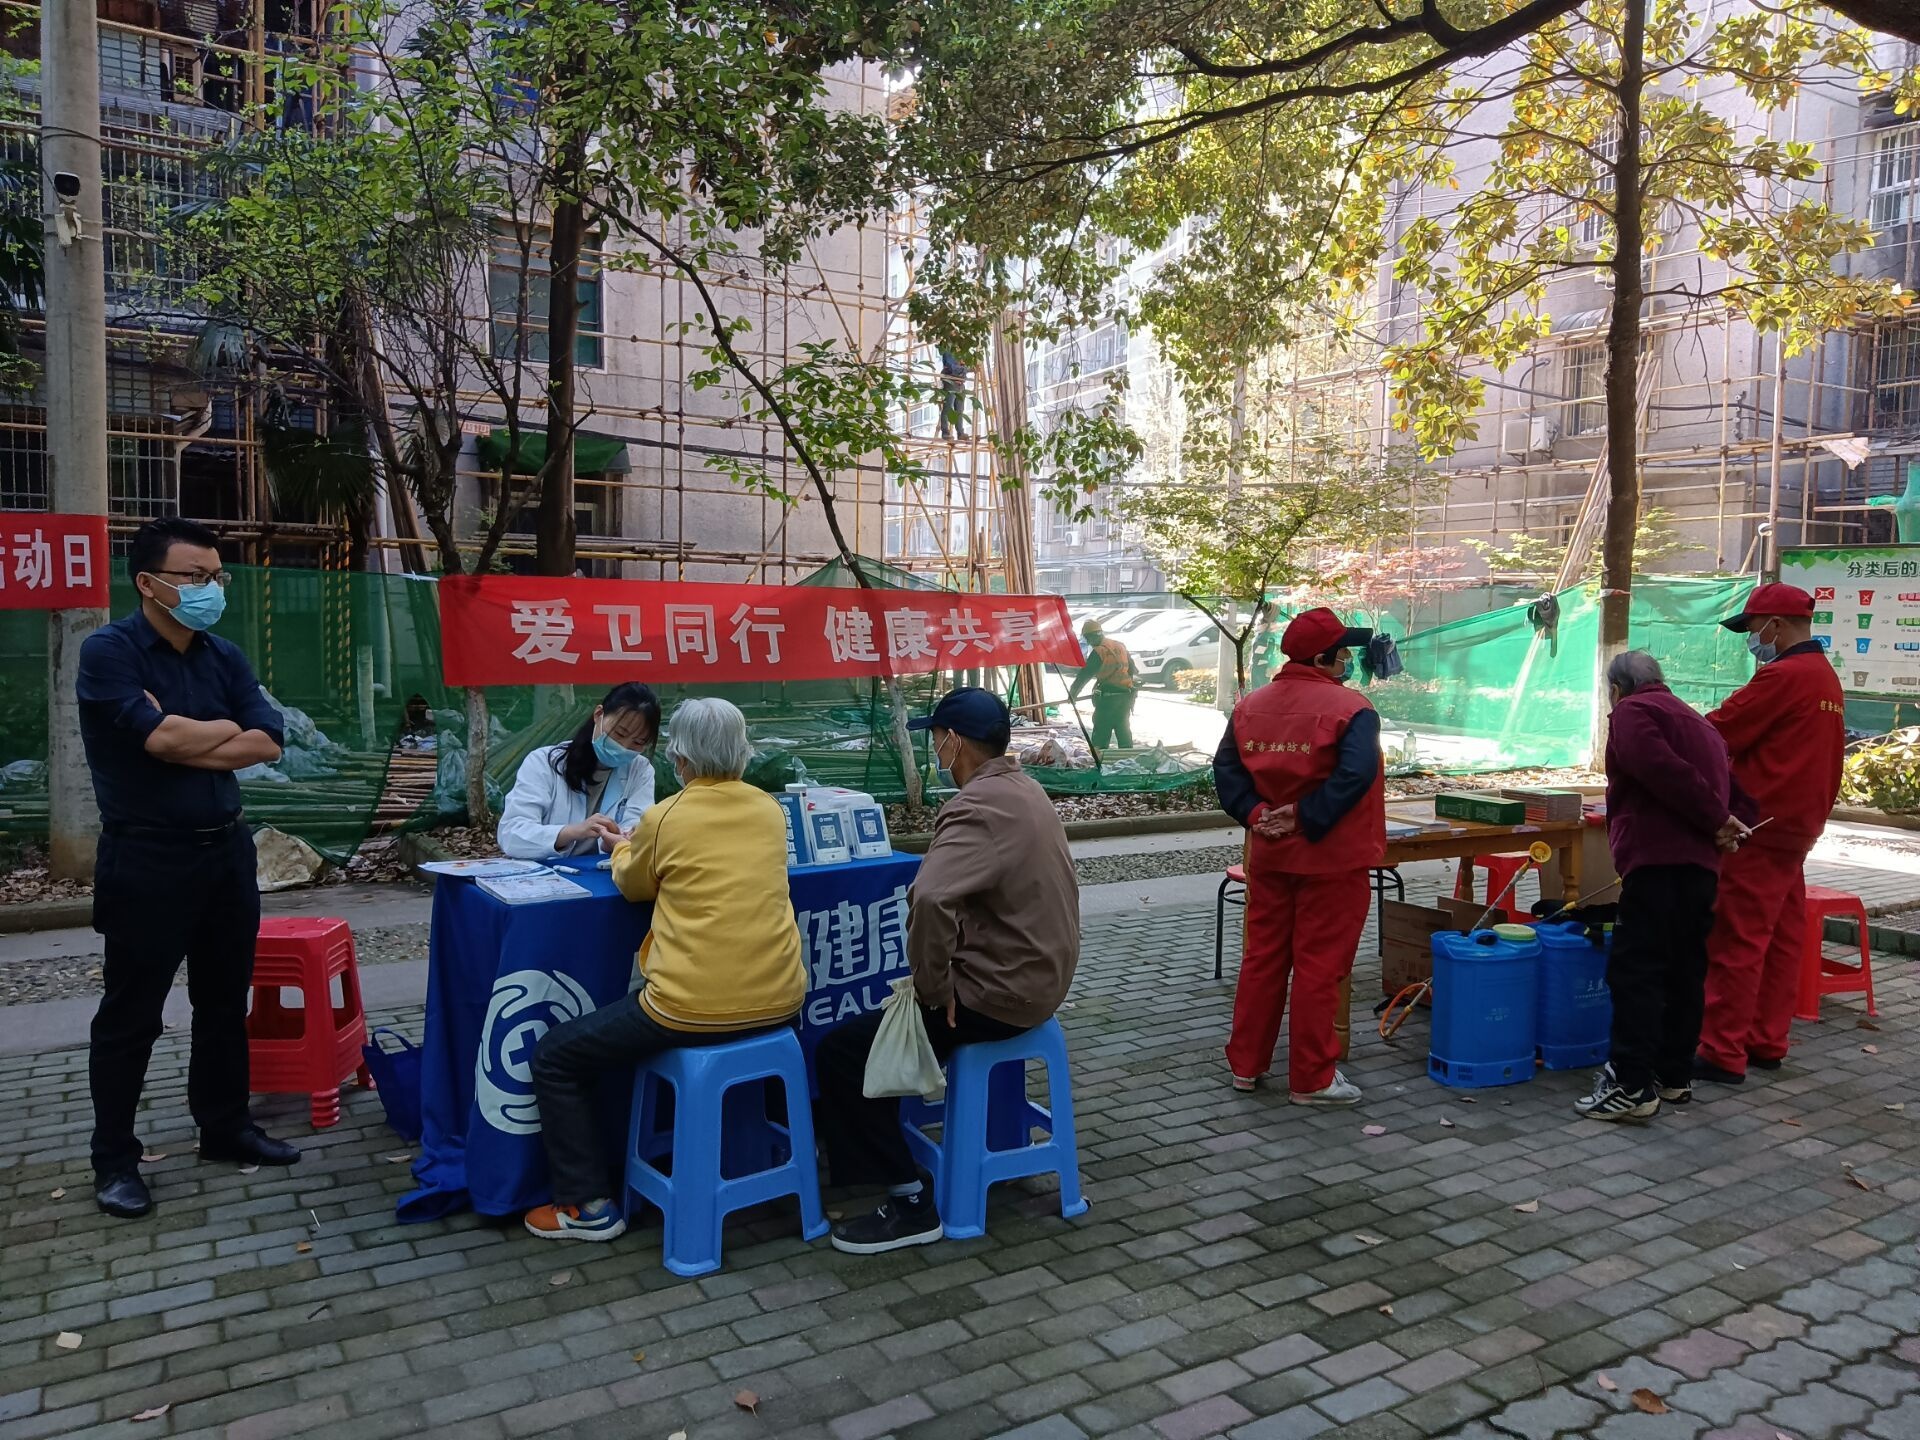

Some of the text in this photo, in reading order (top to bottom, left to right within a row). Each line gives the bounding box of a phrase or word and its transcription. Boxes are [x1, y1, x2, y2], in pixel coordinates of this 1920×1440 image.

[0, 529, 92, 590] 动日
[1847, 560, 1920, 578] 分类后的
[511, 599, 1047, 664] 爱卫同行 健康共享
[800, 975, 913, 1030] EAL
